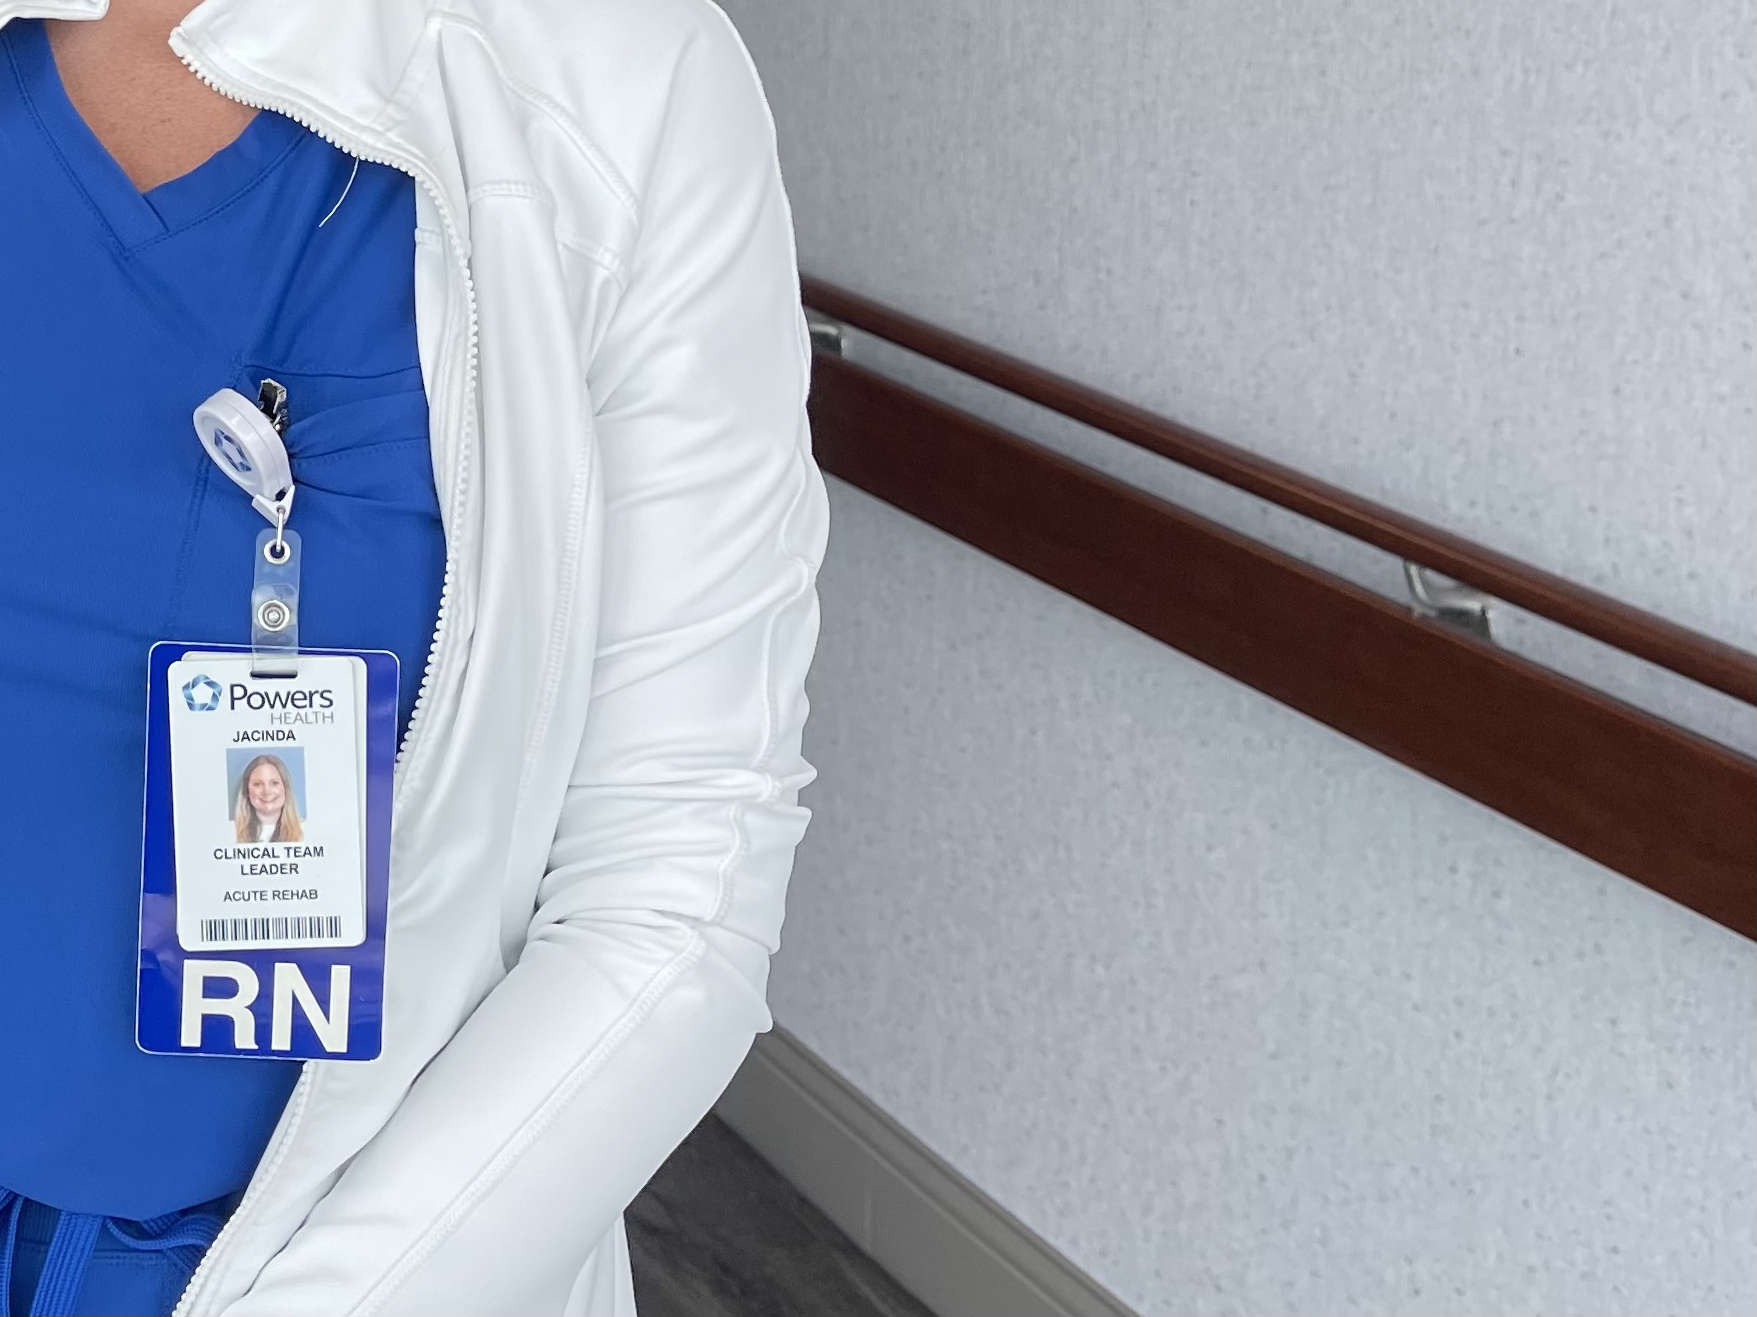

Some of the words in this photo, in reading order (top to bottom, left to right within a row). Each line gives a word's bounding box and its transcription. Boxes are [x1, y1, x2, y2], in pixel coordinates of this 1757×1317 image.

[229, 683, 334, 710] Powers
[270, 711, 334, 725] HEALTH
[232, 730, 296, 743] JACINDA
[213, 847, 280, 860] CLINICAL
[285, 846, 324, 858] TEAM
[240, 863, 299, 876] LEADER
[223, 890, 269, 902] ACUTE
[272, 889, 319, 901] REHAB
[180, 959, 351, 1053] RN
